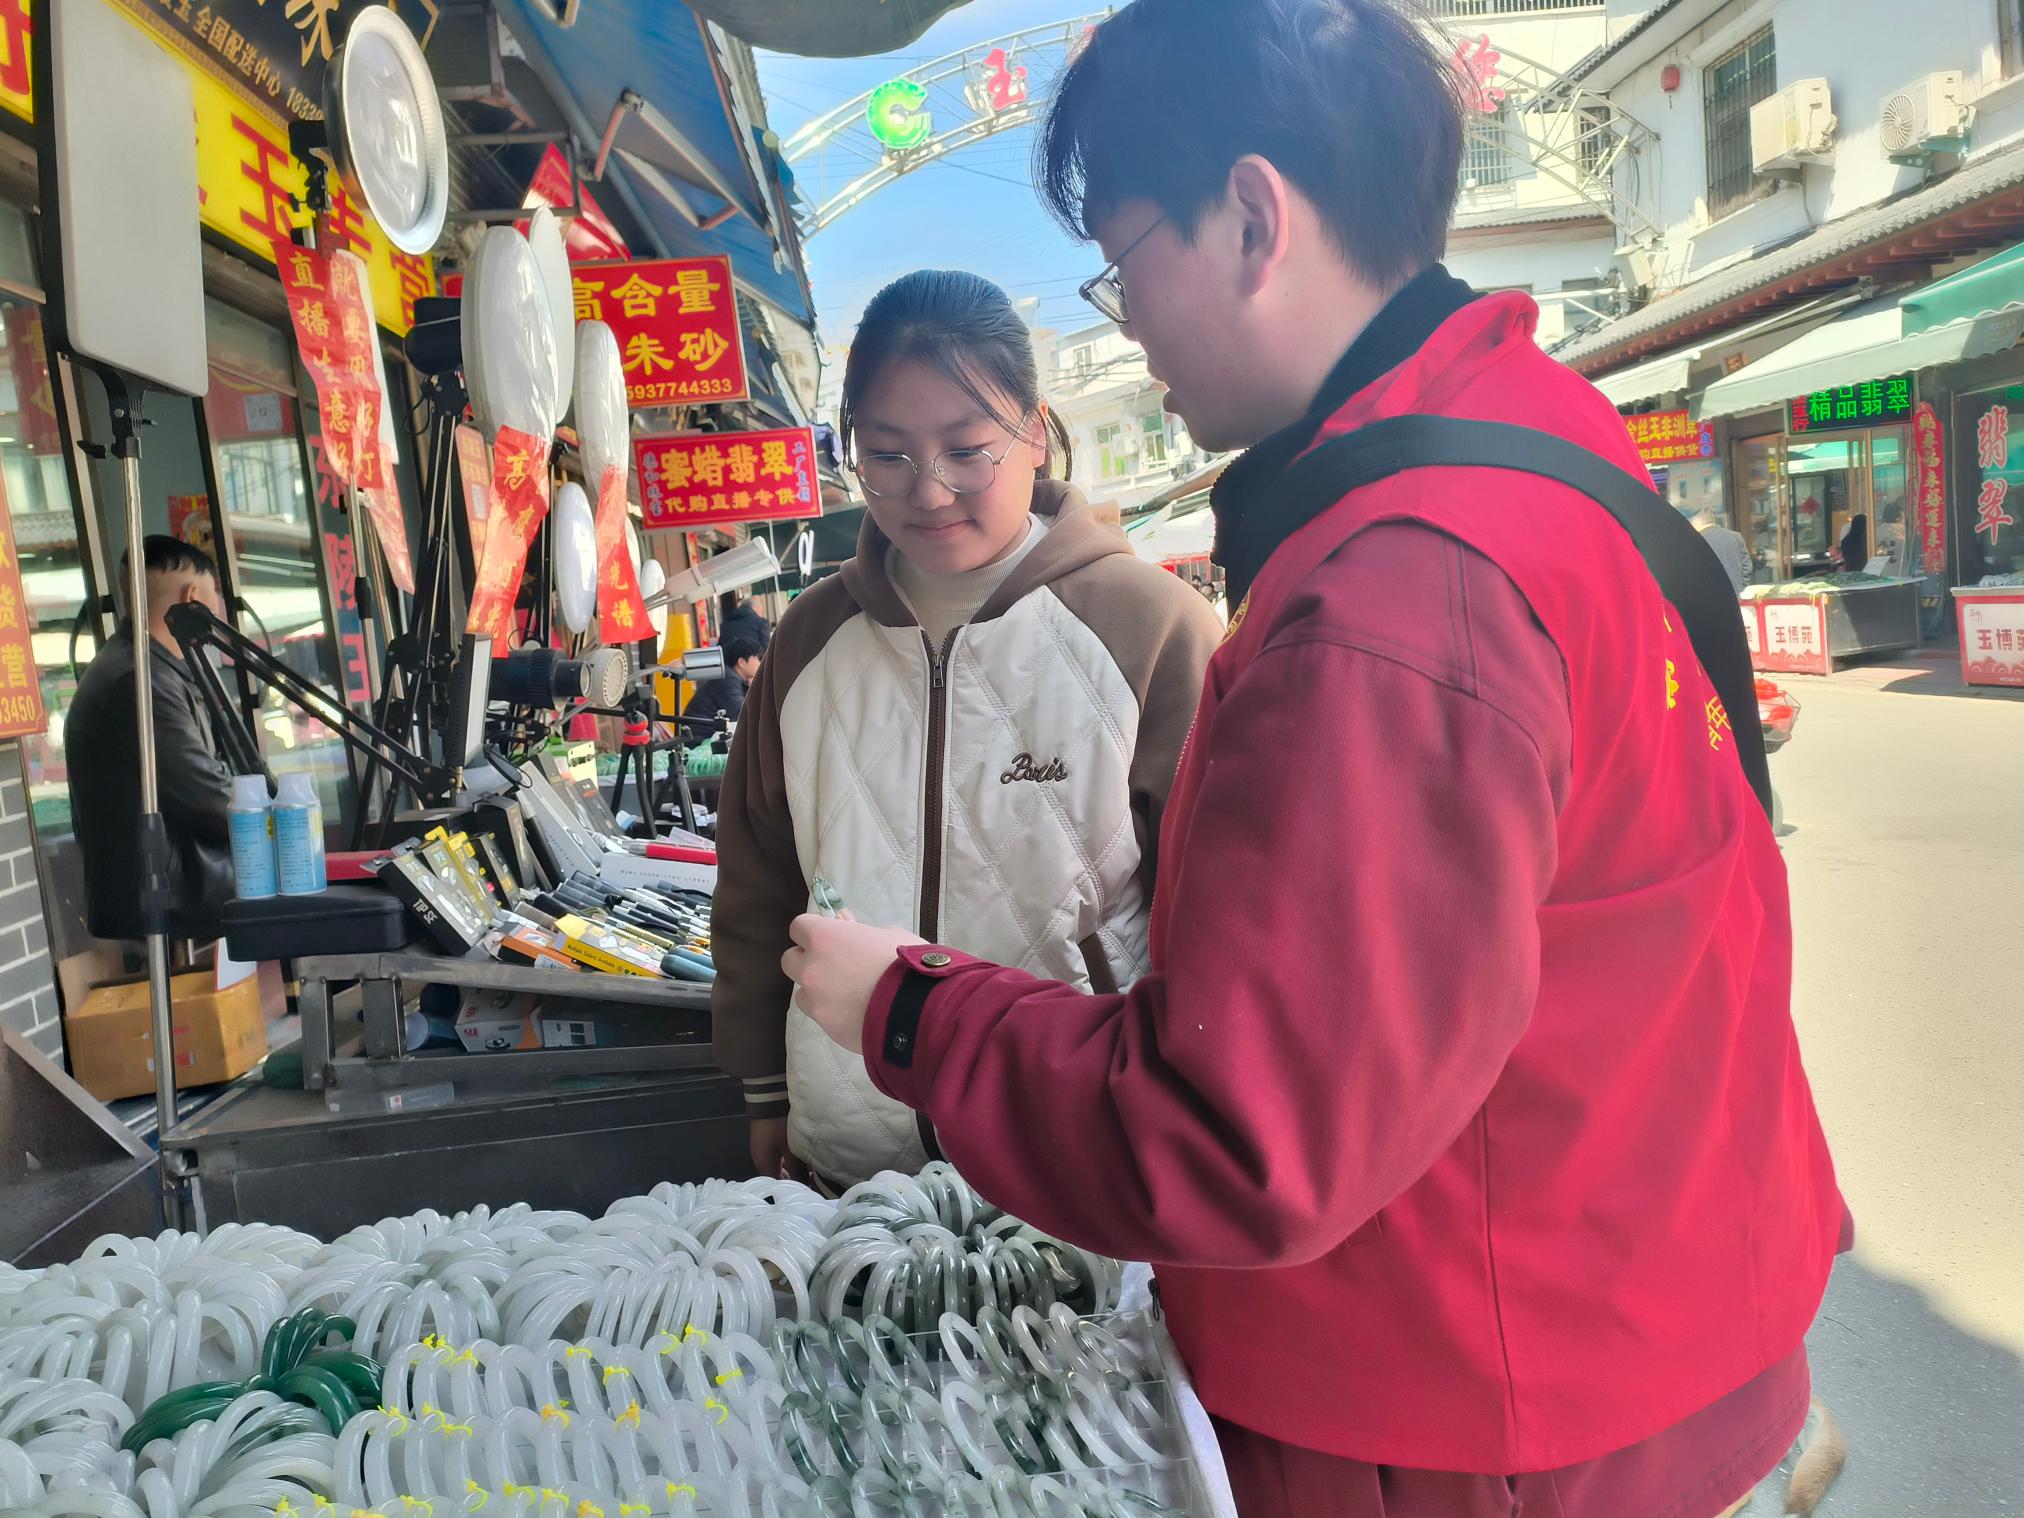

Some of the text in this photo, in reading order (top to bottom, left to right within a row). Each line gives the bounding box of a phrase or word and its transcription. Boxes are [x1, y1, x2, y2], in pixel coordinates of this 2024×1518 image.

[192, 5, 281, 97] 全国配送中心
[573, 269, 721, 322] 高含量
[622, 327, 730, 376] 朱砂
[1809, 379, 1911, 423] 精品翡翠
[660, 441, 793, 490] 蜜蜡翡翠
[1975, 404, 2014, 546] 翡翠
[664, 487, 796, 514] 代购直播专供
[1775, 625, 1813, 644] 玉博苑
[0, 692, 36, 724] 3450
